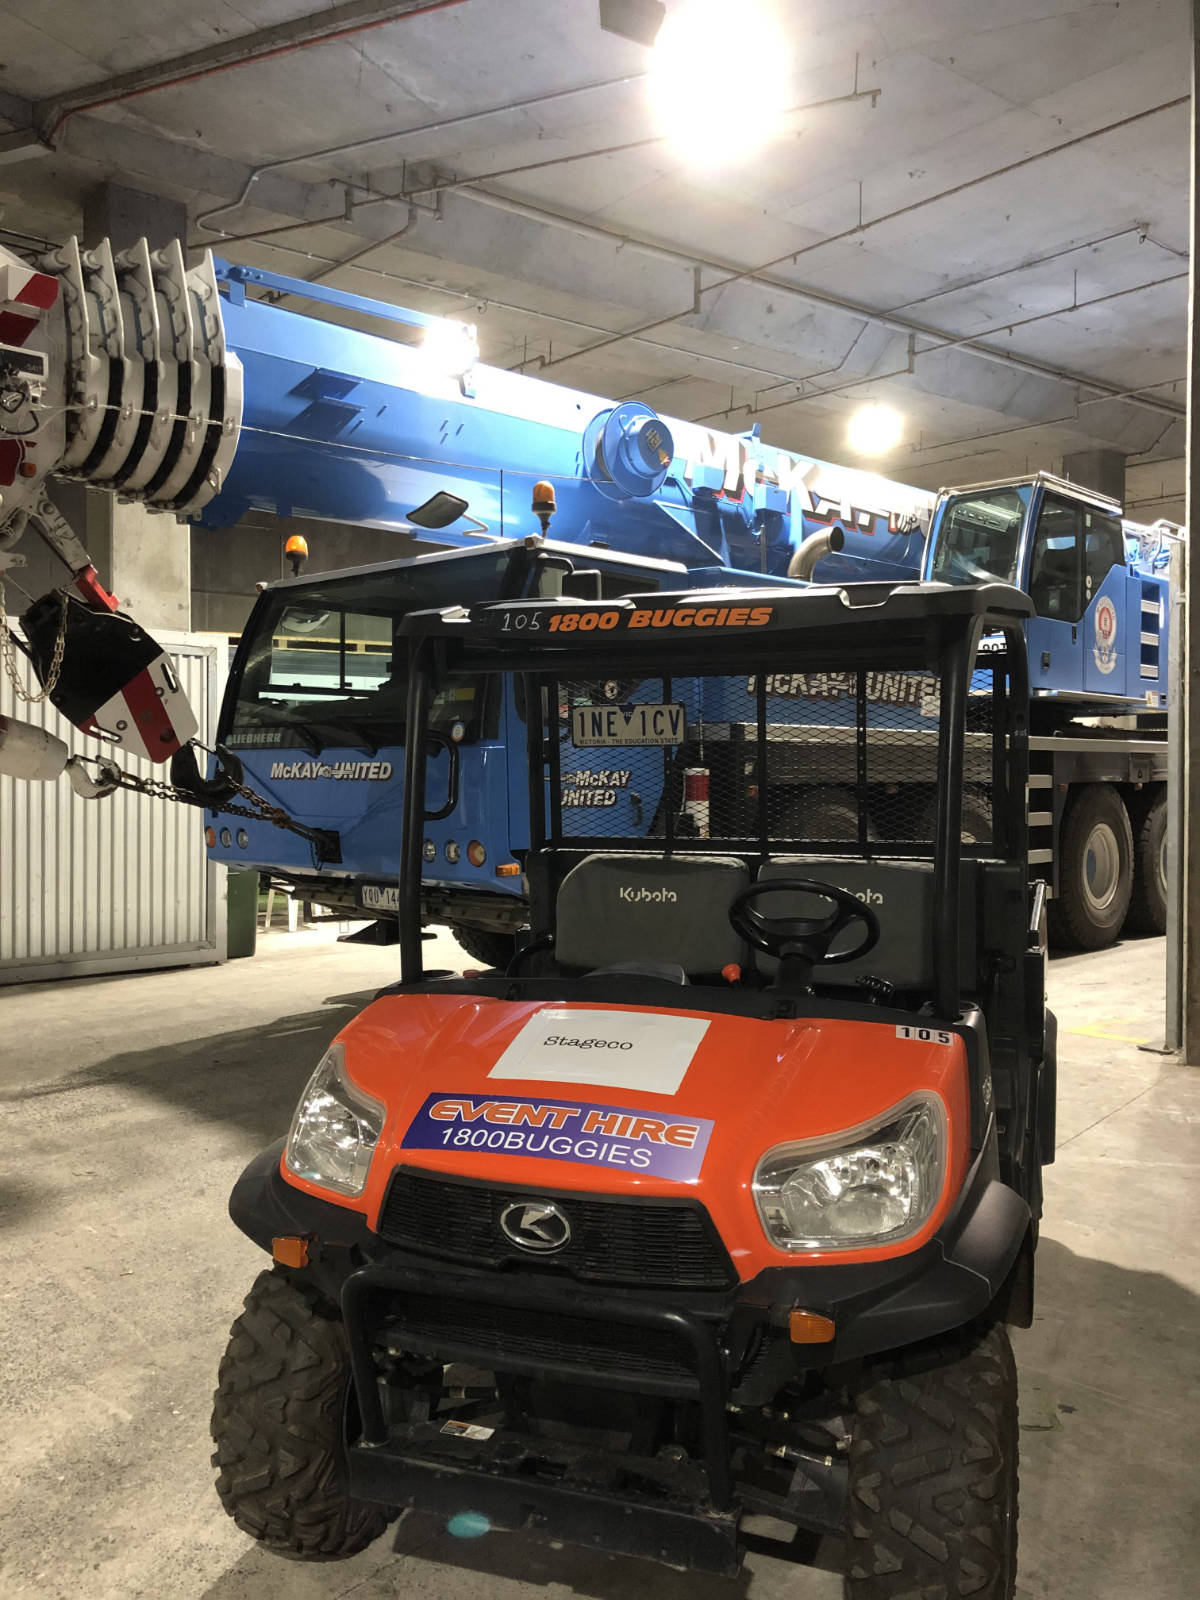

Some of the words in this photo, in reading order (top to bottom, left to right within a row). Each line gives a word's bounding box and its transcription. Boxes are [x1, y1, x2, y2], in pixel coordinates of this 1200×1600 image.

[501, 611, 542, 631] 105
[549, 611, 620, 632] 1800
[627, 607, 773, 628] BUGGIES
[579, 711, 617, 737] 1NE
[641, 709, 680, 736] 1CV
[232, 732, 281, 744] LIEBHERR
[271, 762, 322, 780] McKAY
[334, 762, 392, 780] UNITED
[576, 770, 631, 788] McKAY
[620, 887, 677, 902] Kubota
[543, 1035, 633, 1051] Stageco
[429, 1099, 581, 1129] EVENT
[581, 1110, 700, 1148] HIRE
[441, 1127, 652, 1168] 1800BUGGIES
